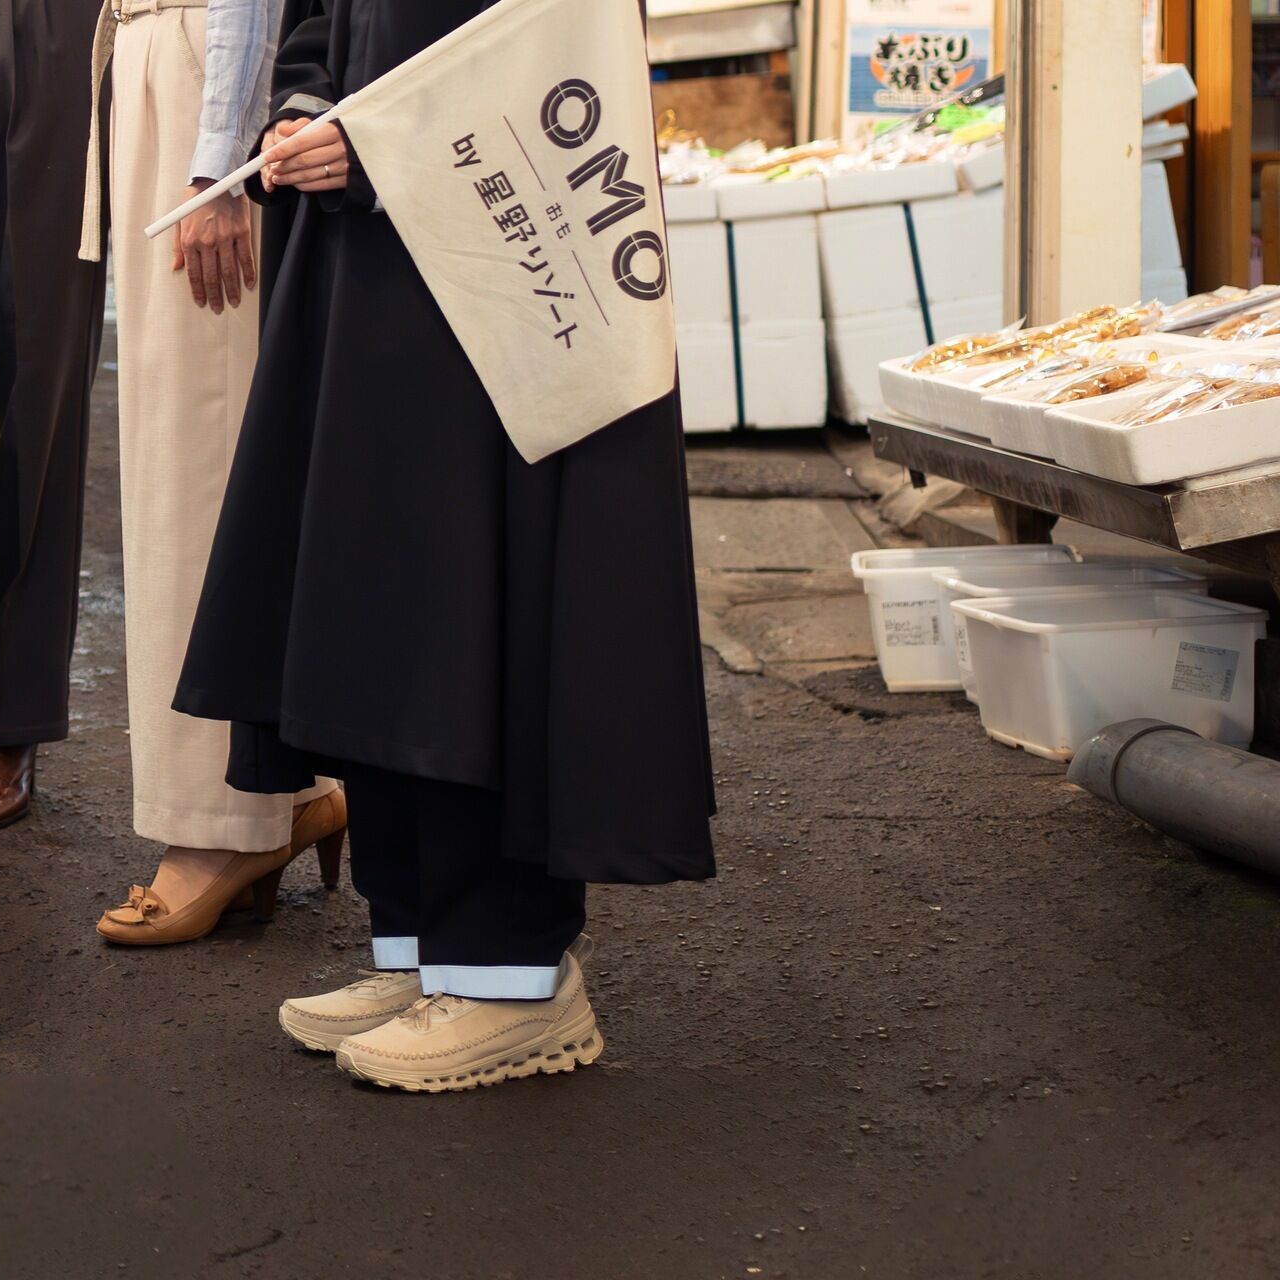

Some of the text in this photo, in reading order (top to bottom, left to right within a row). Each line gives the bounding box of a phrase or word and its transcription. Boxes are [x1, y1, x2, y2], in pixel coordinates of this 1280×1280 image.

[876, 32, 969, 62] あぶり
[450, 131, 579, 350] by 星野リゾート
[540, 77, 667, 302] OMO
[545, 201, 571, 241] おも
